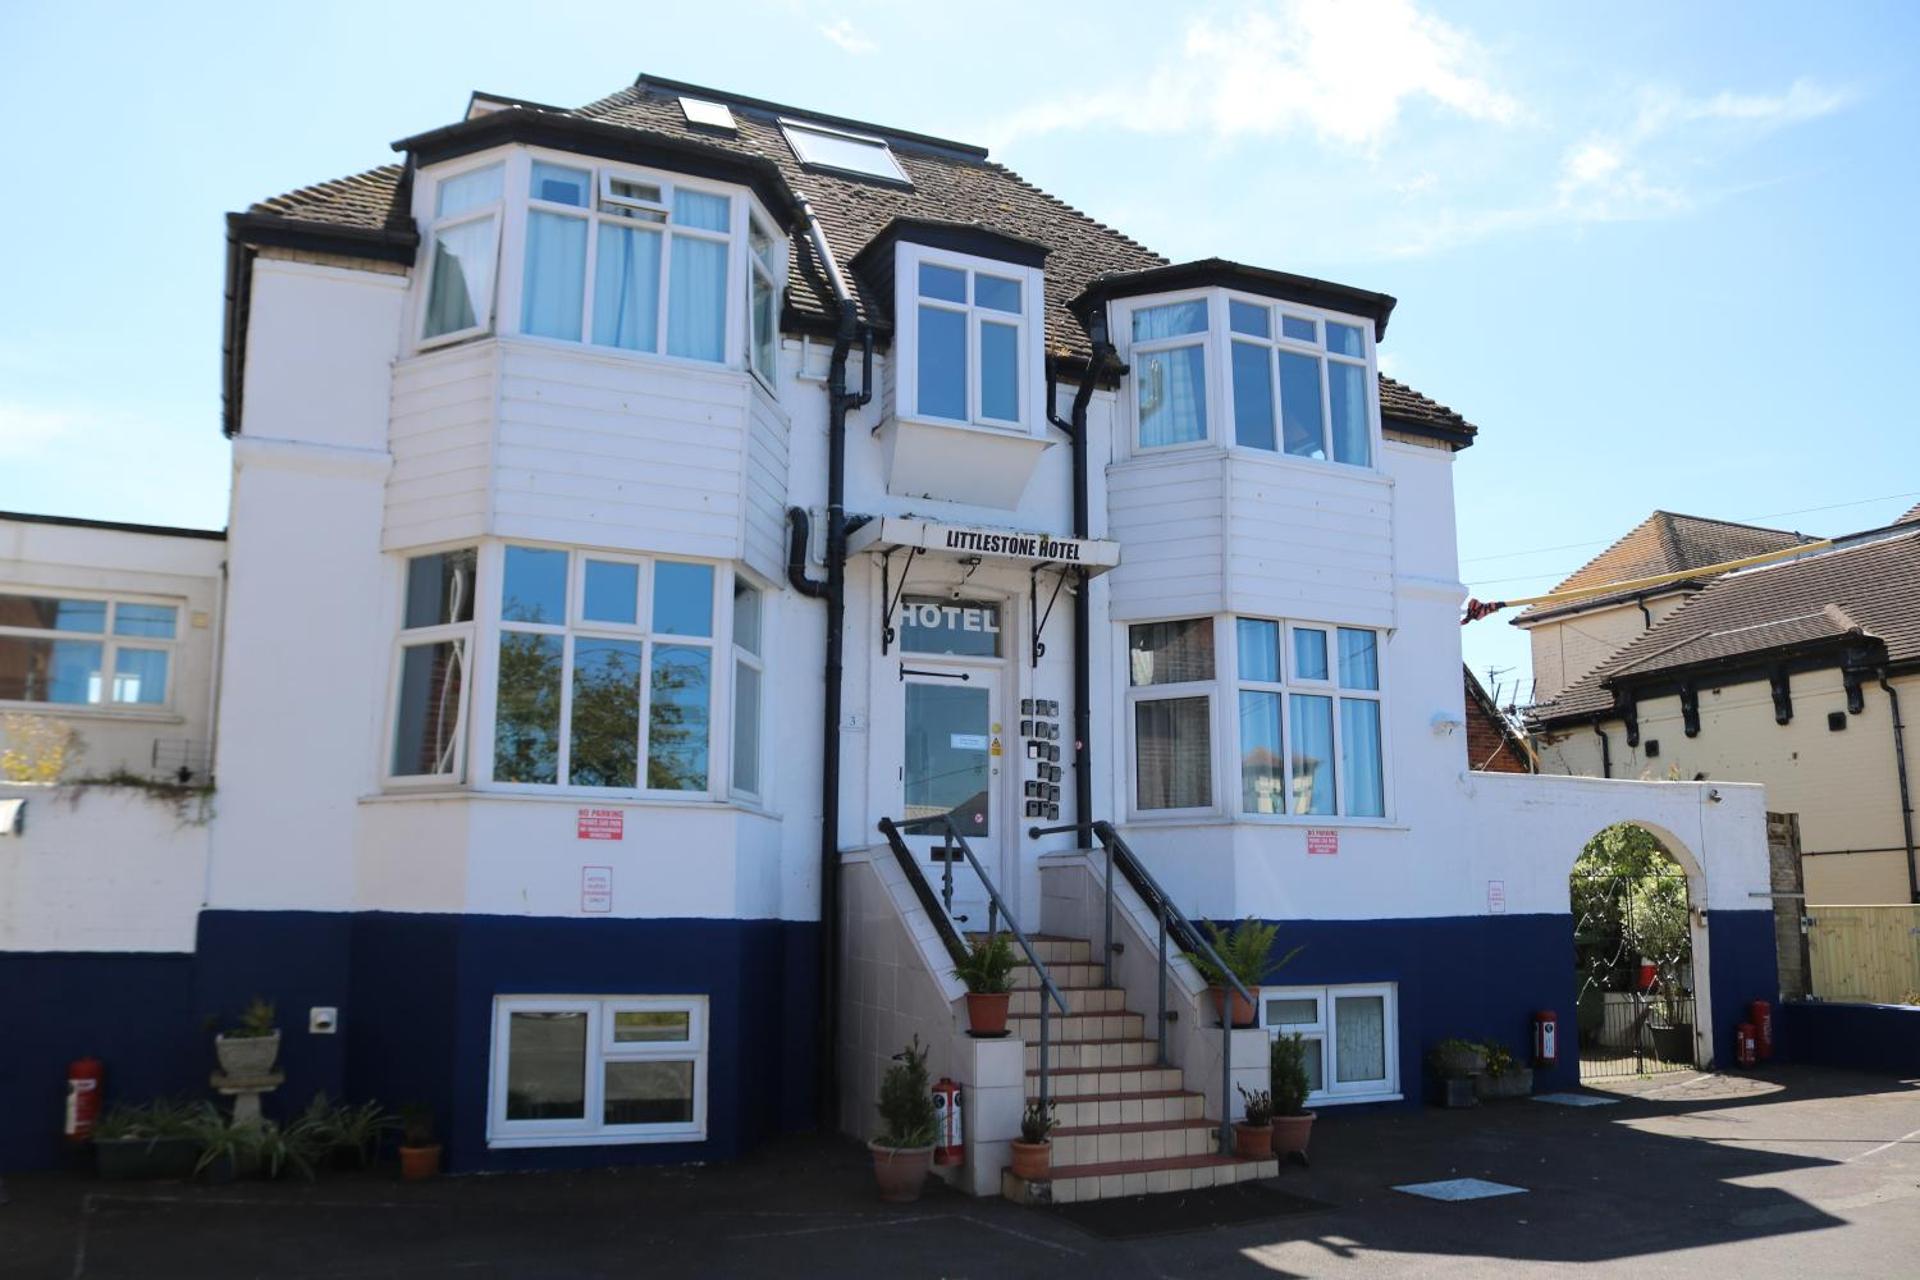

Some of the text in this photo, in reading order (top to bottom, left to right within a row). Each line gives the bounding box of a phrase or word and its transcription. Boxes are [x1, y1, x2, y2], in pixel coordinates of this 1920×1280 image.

[946, 530, 1080, 560] LITTLESTONE HOTEL
[900, 602, 1000, 633] HOTEL
[591, 809, 624, 818] PARKING
